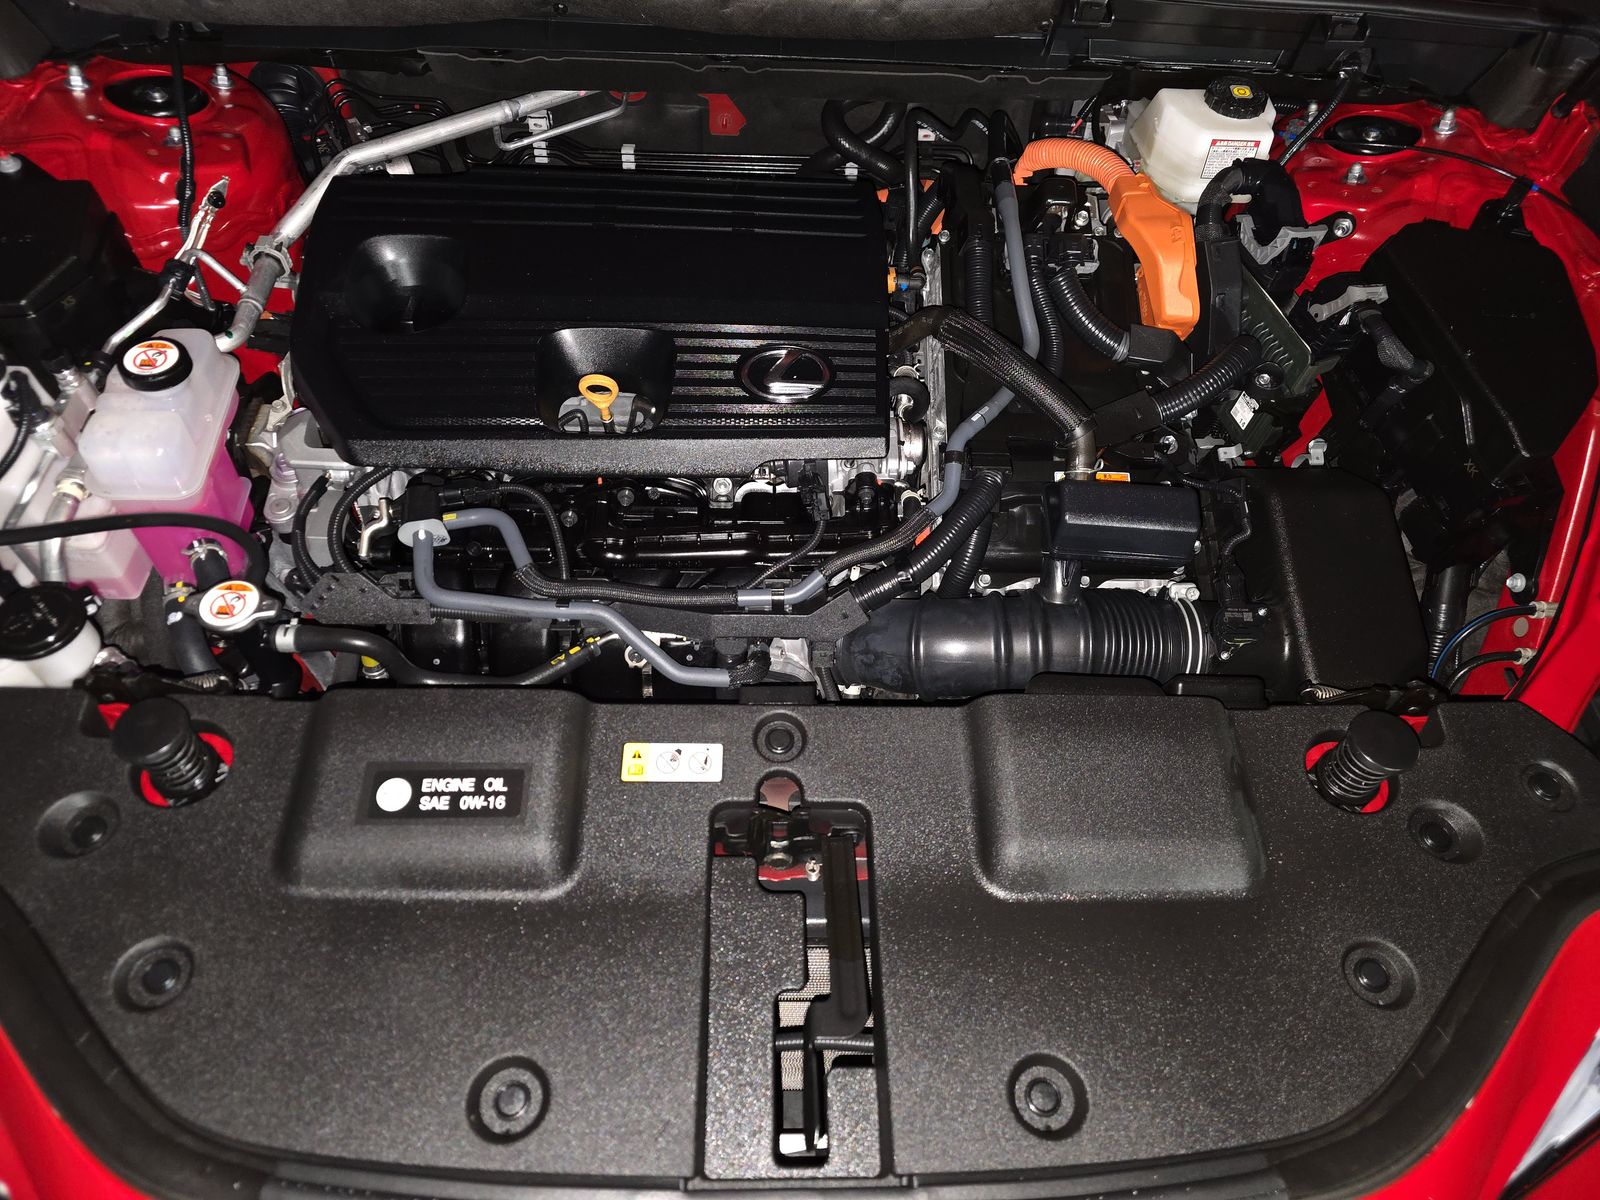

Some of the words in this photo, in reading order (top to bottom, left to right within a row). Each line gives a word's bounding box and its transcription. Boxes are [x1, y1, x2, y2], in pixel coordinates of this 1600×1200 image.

[421, 777, 477, 793] ENGINE
[483, 777, 509, 793] OIL
[418, 796, 451, 811] SAE
[459, 795, 507, 811] 0W-16
